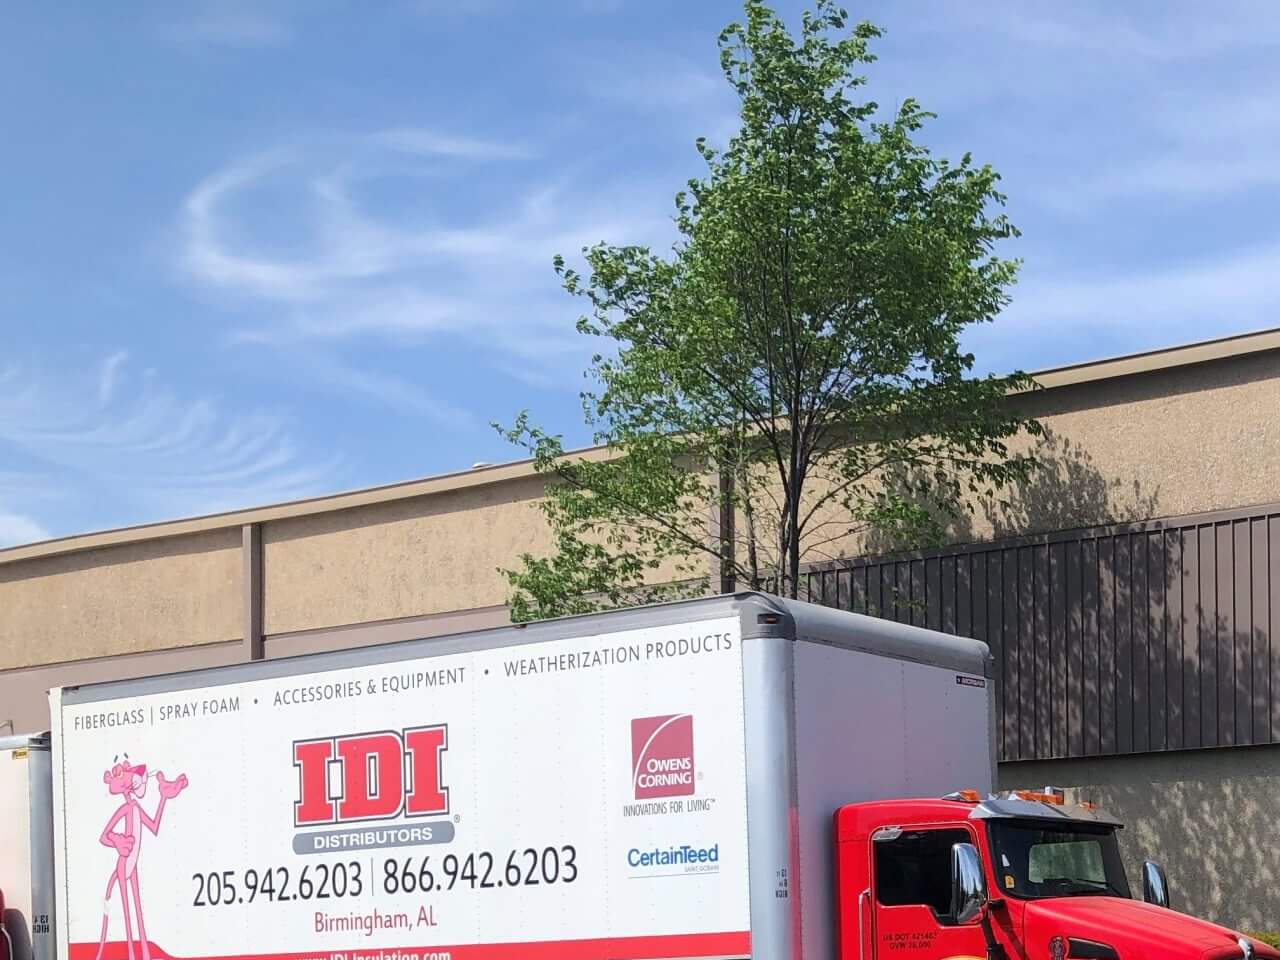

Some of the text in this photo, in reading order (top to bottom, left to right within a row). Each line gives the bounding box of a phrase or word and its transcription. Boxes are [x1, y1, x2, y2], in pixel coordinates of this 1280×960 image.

[74, 632, 732, 731] FIBERGLASS SPRAY FOAM ACCESSORIES & EQUIPMENT WEATHERIZATION PRODUCTS
[292, 723, 450, 828] IDI
[646, 756, 692, 773] OWENS
[638, 771, 692, 788] CORNING
[623, 801, 668, 817] INNOVATIONS
[669, 800, 683, 814] FOR
[313, 827, 433, 849] DISTRIBUTORS
[627, 843, 719, 868] CertainTeed
[191, 844, 579, 907] 205.942.6203 866.942.6203
[314, 904, 437, 937] Birmingham, AL
